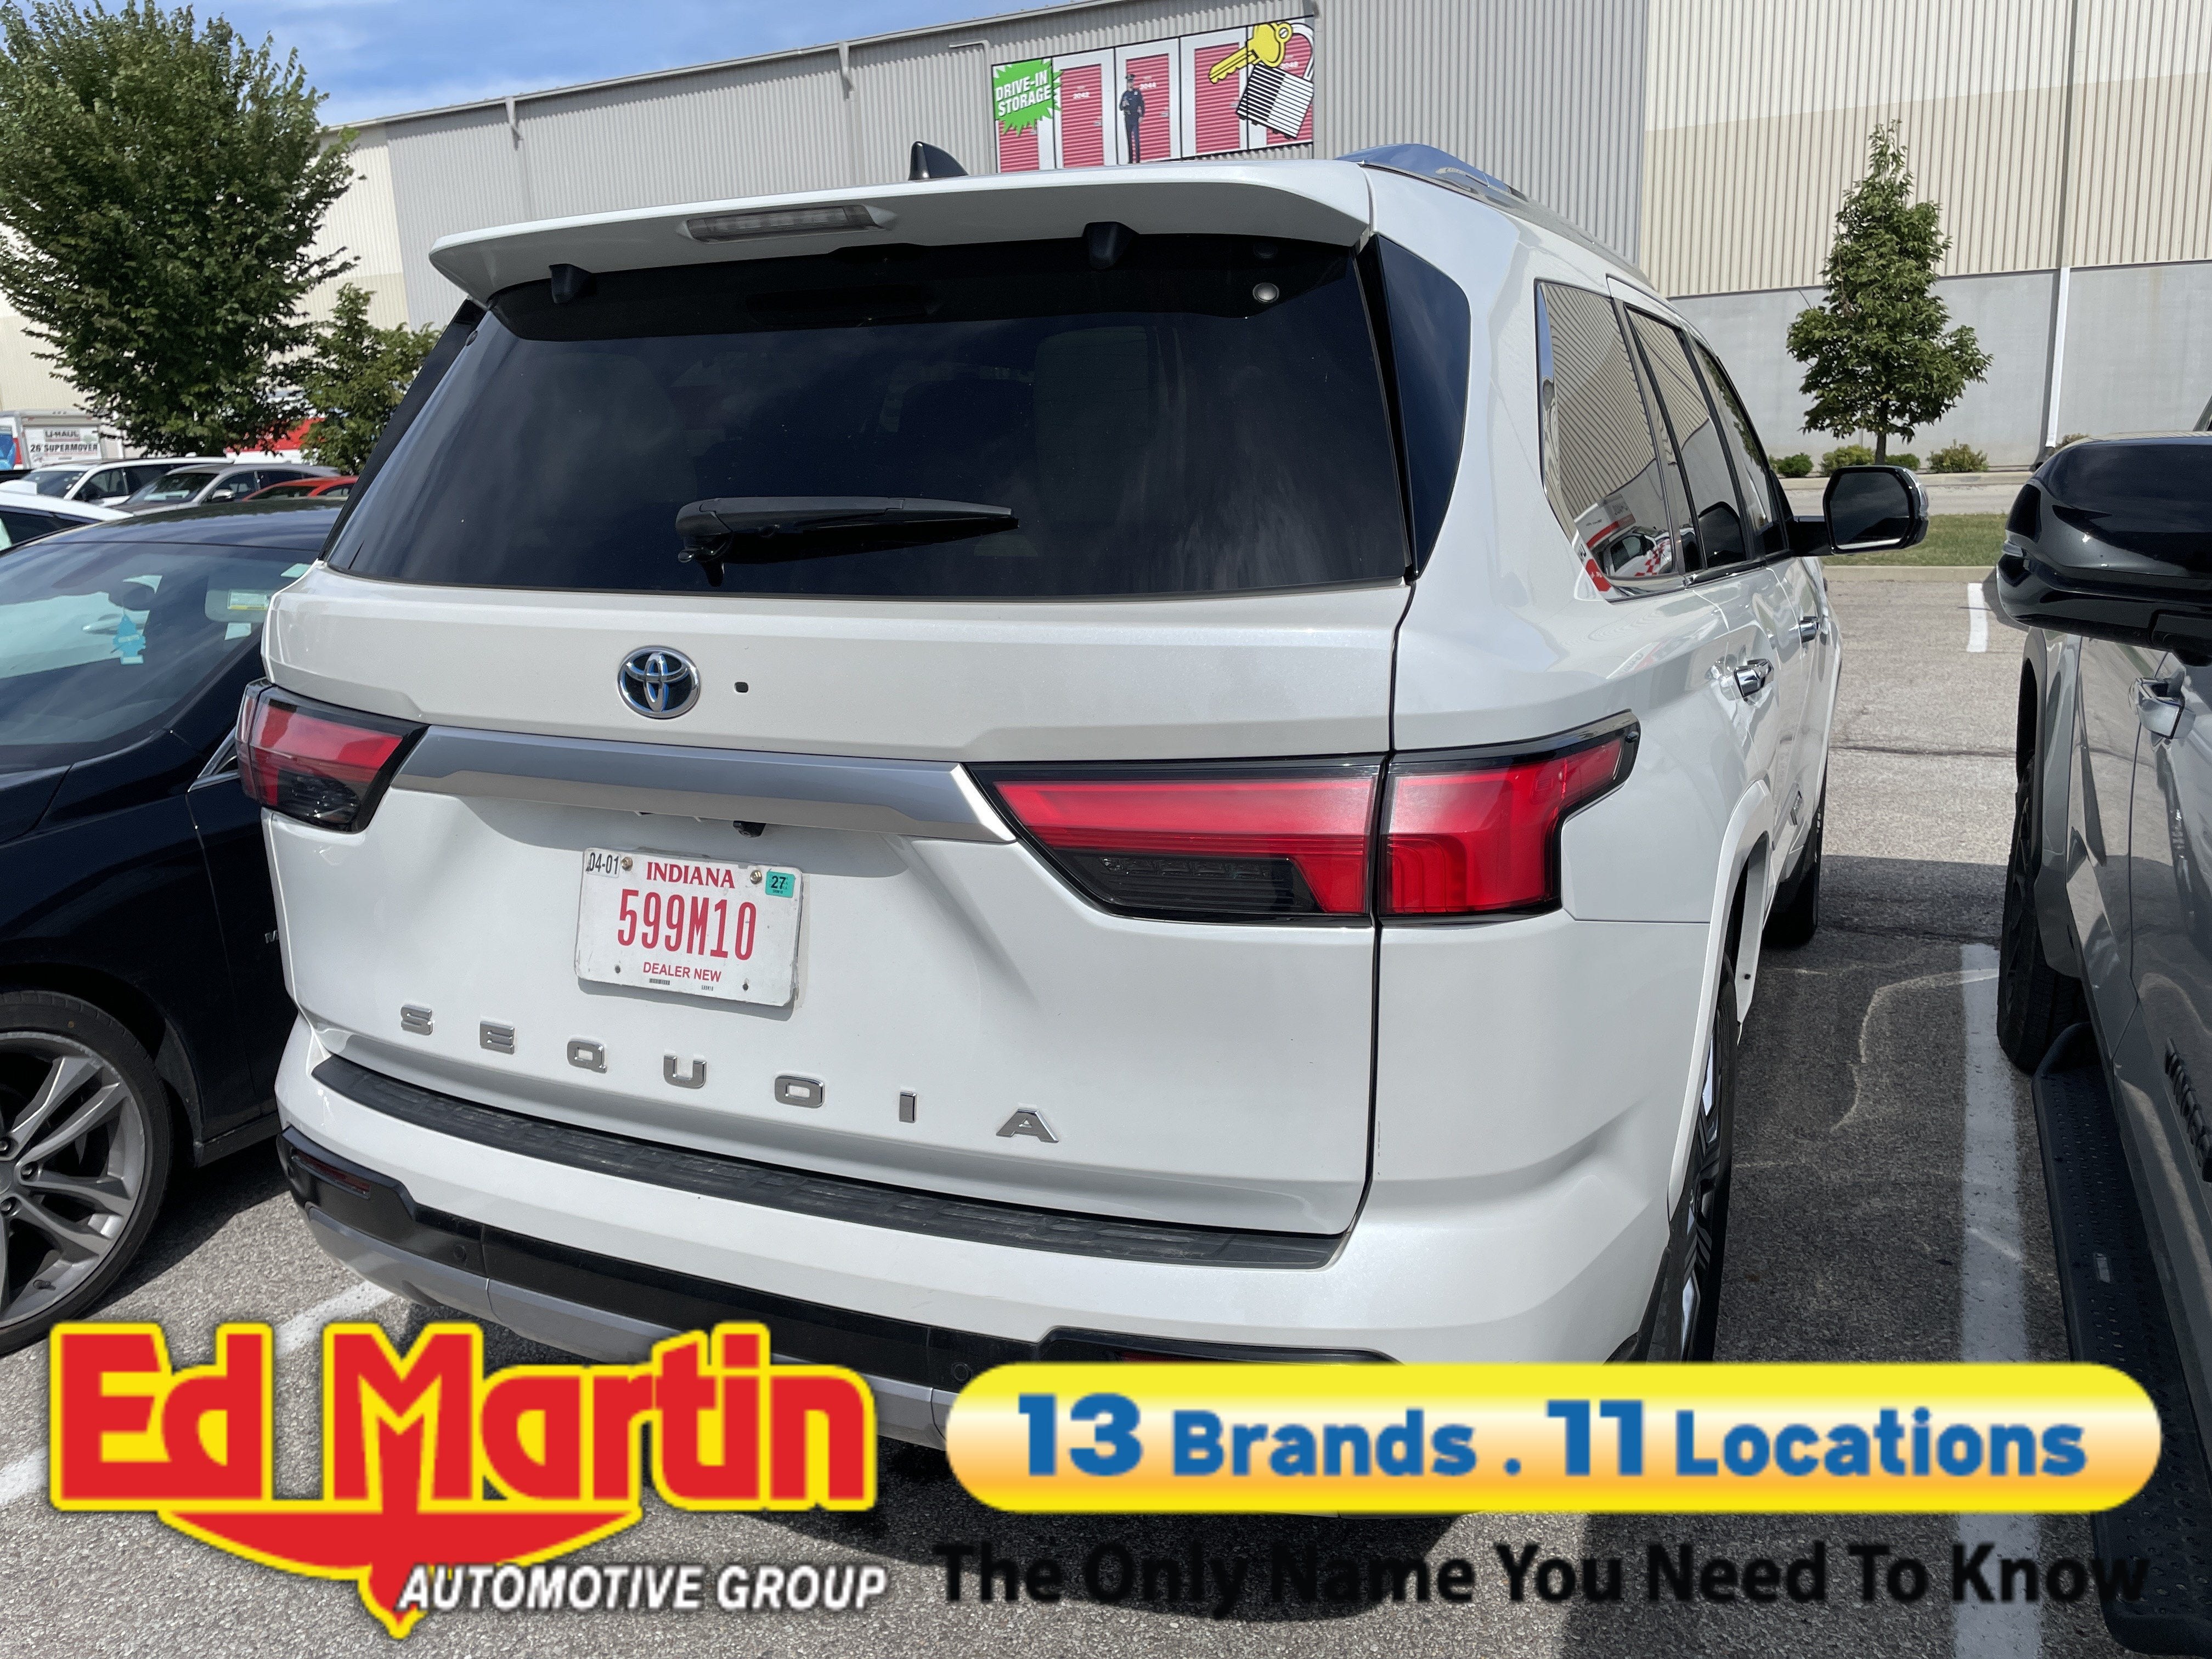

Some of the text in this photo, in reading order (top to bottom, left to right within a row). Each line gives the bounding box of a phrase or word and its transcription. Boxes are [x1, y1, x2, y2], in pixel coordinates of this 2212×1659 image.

[996, 70, 1047, 101] DRIVE-IN
[998, 85, 1051, 117] STORAGE
[44, 443, 98, 452] SUPERMOVER
[589, 852, 619, 874] 04-01
[646, 861, 735, 889] INDIANA
[771, 876, 786, 889] 27
[617, 888, 757, 961] 599M10
[643, 962, 721, 983] DEALER NEW
[400, 1004, 1060, 1144] SEQUOIA
